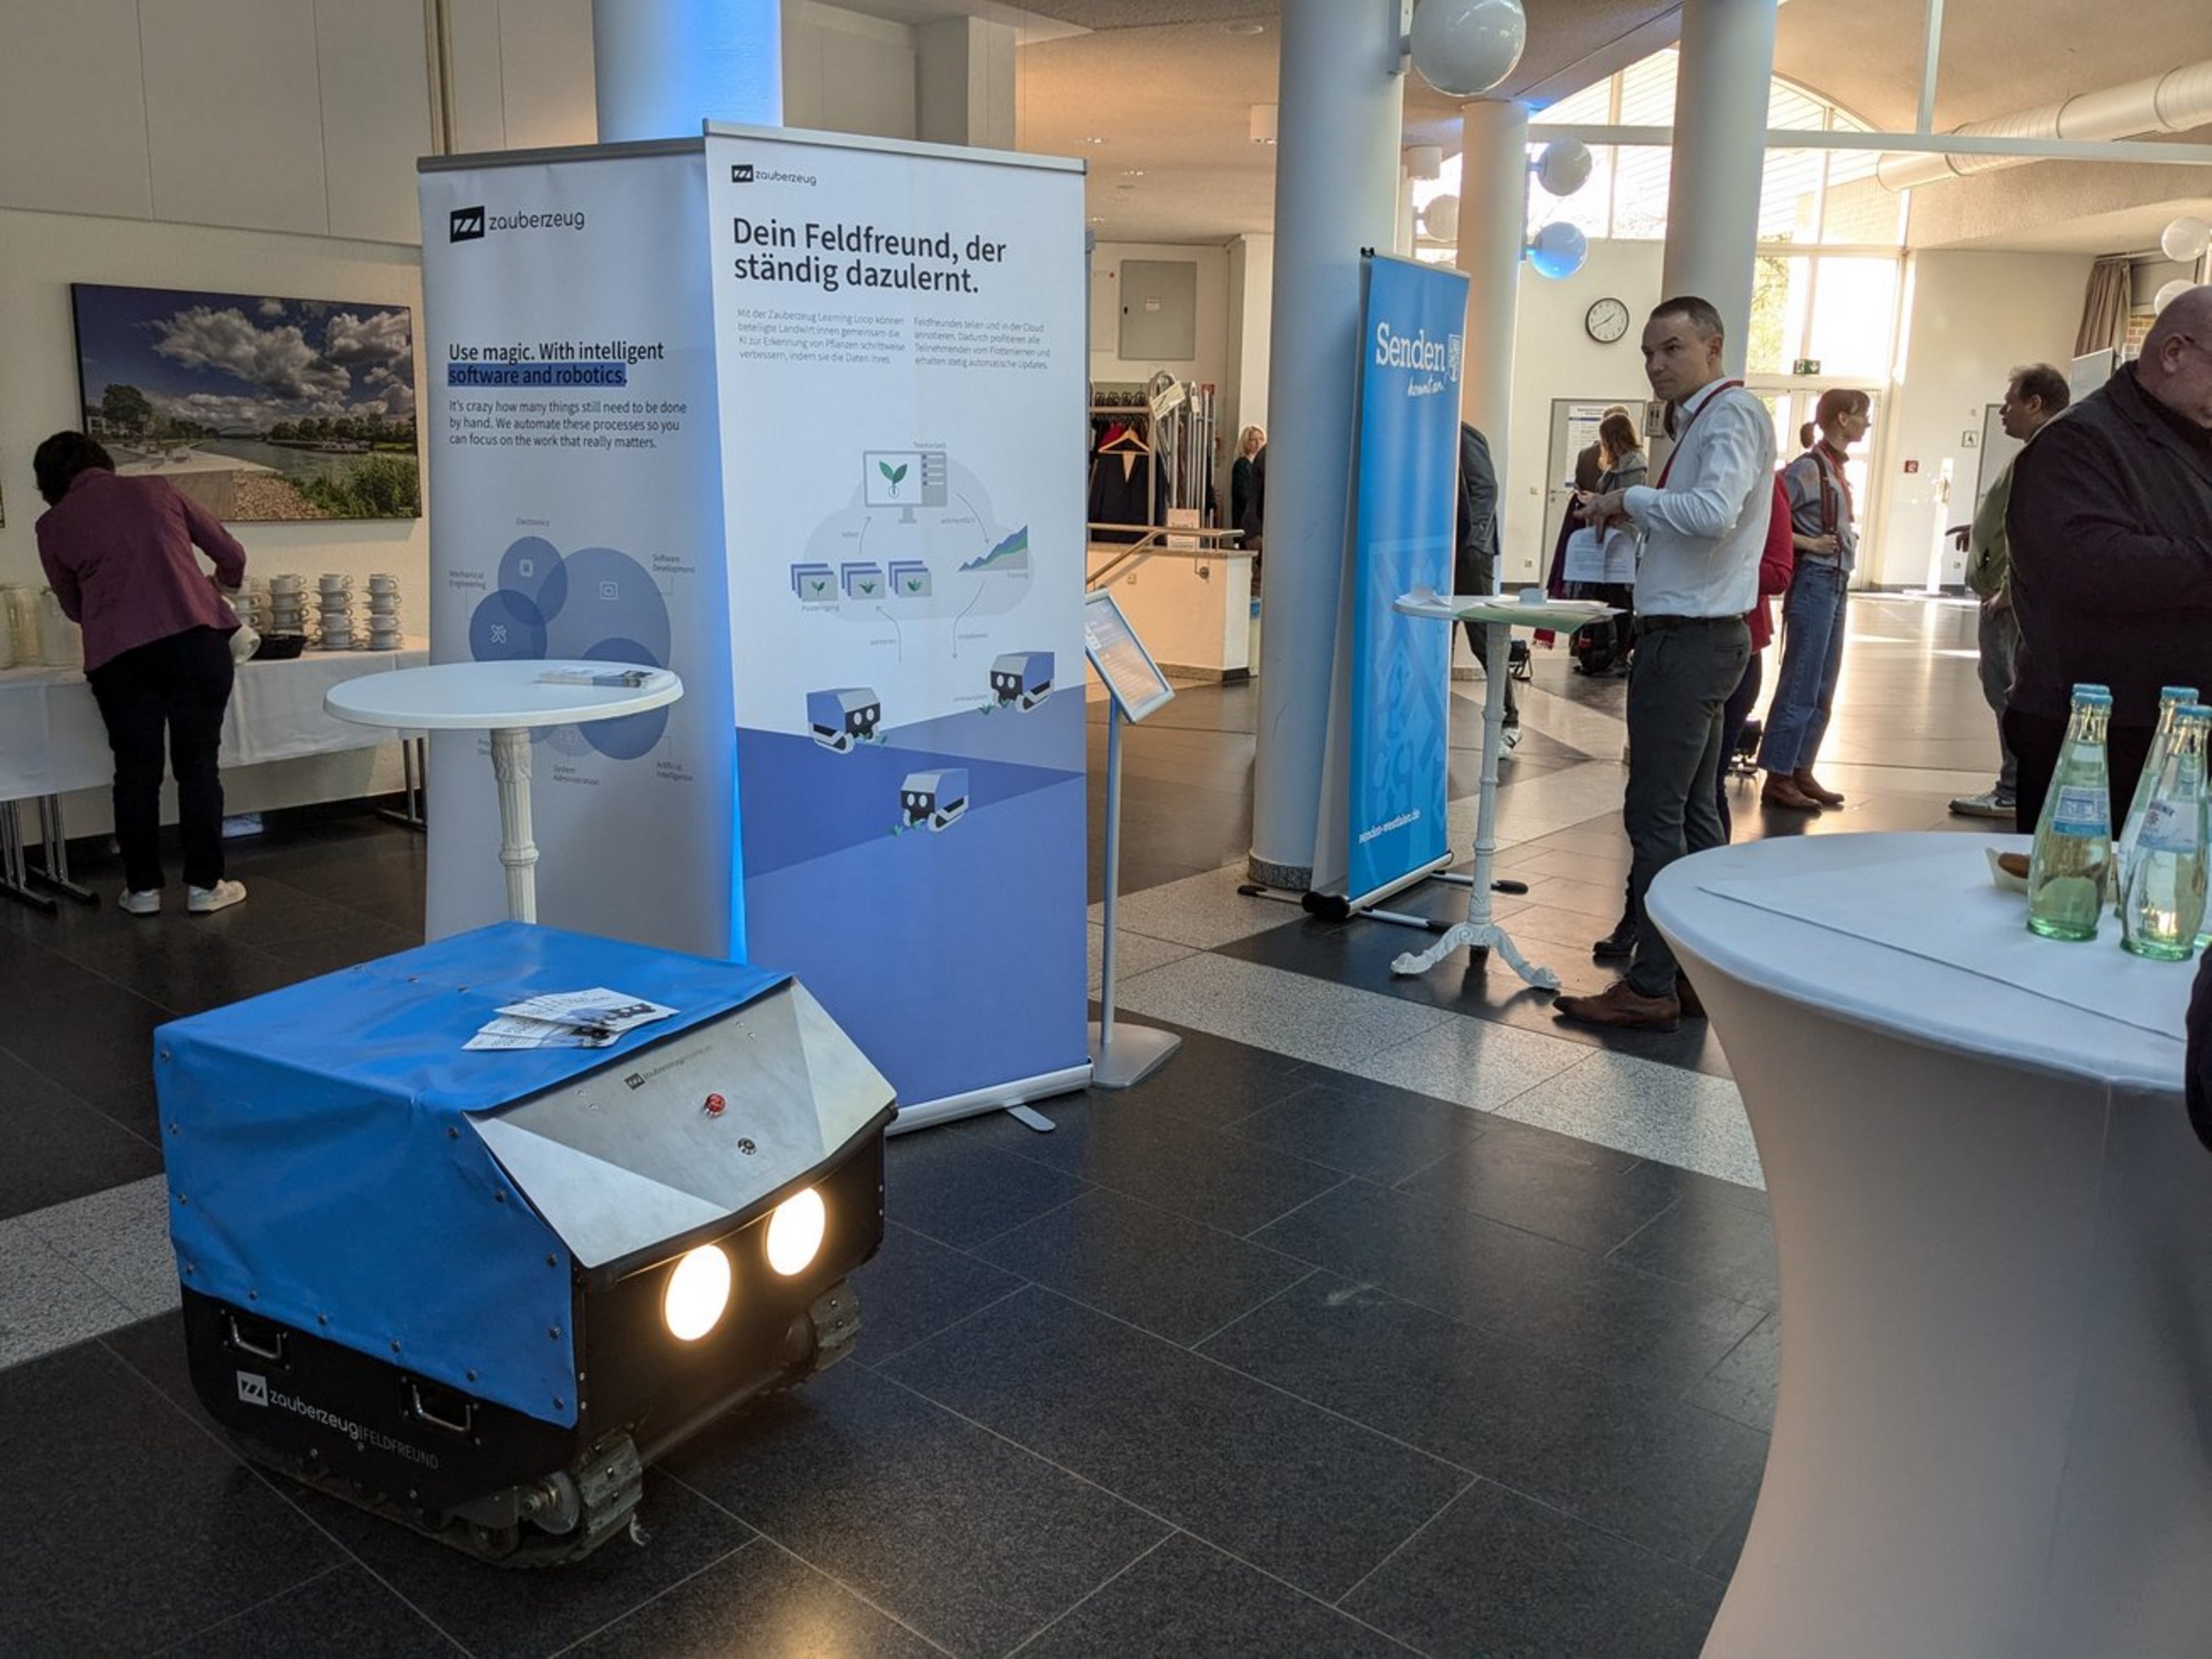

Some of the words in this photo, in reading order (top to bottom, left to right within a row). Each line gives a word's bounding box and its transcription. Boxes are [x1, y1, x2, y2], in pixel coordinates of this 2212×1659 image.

[756, 170, 817, 186] zauberzeug
[489, 209, 585, 230] zauberzeug
[733, 217, 796, 248] Dein
[805, 223, 959, 264] Feldfreund,
[966, 235, 1006, 263] der
[734, 253, 838, 292] ständig
[846, 259, 979, 293] dazulernt.
[753, 310, 766, 318] der
[449, 344, 478, 361] Use
[483, 344, 535, 366] magic.
[539, 342, 574, 360] With
[579, 341, 664, 365] intelligent
[1376, 322, 1445, 371] Senden
[449, 366, 519, 384] software
[523, 366, 552, 383] and
[556, 364, 628, 385] robotics.
[449, 400, 465, 411] It's
[466, 402, 493, 413] crazy
[495, 400, 516, 412] how
[519, 403, 547, 414] many
[549, 400, 579, 415] things
[581, 400, 601, 413] still
[603, 401, 630, 413] need
[632, 402, 643, 413] to
[646, 401, 659, 413] be
[660, 402, 687, 413] done
[449, 417, 461, 430] by
[463, 417, 494, 429] hand.
[495, 418, 512, 429] We
[514, 419, 561, 430] automate
[563, 419, 591, 431] these
[593, 421, 646, 433] processes
[648, 422, 659, 431] so
[660, 422, 680, 434] you
[449, 435, 467, 444] can
[469, 433, 498, 446] focus
[500, 436, 513, 445] on
[514, 434, 532, 447] the
[534, 435, 559, 447] work
[560, 435, 581, 447] that
[583, 435, 612, 450] really
[614, 437, 657, 449] matters.
[270, 1389, 359, 1440] zauberzeug
[364, 1429, 438, 1469] FELDFREUND
